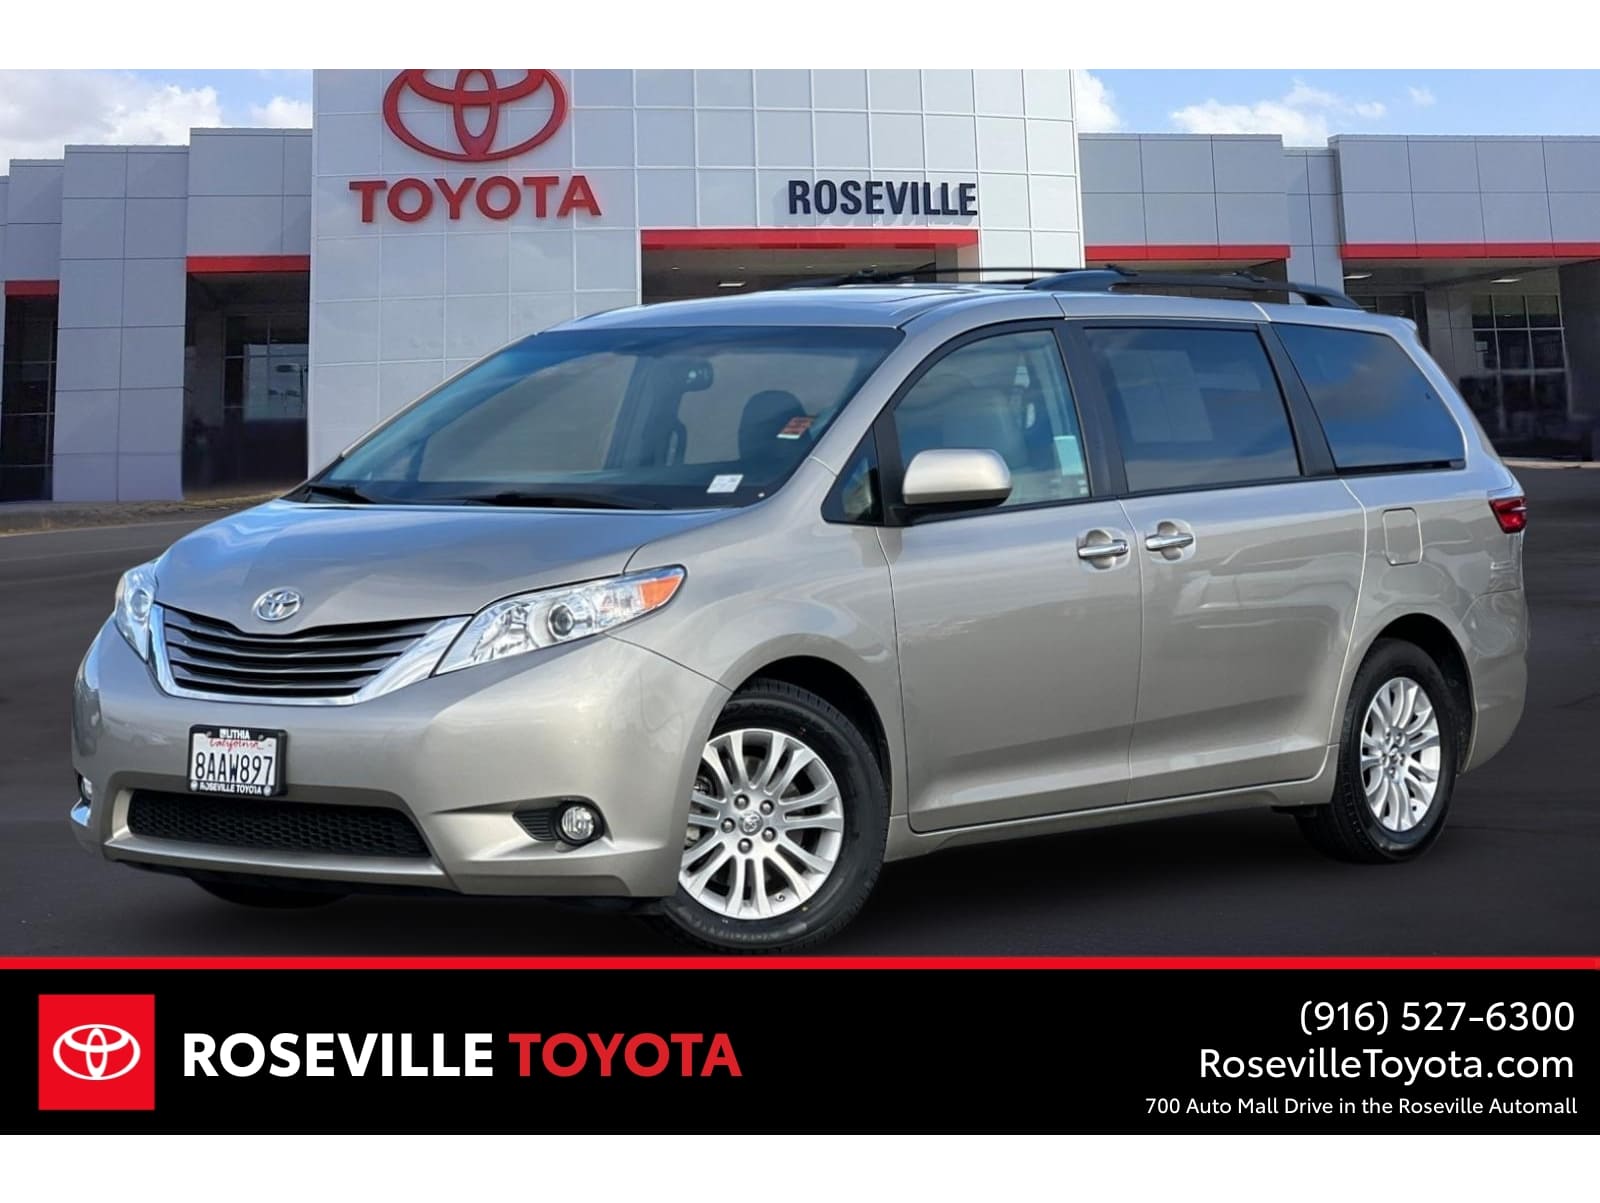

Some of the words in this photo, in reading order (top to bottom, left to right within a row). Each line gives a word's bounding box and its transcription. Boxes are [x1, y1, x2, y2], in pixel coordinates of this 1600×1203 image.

[349, 175, 602, 223] TOYOTA
[788, 180, 978, 216] ROSEVILLE
[227, 729, 250, 740] LITHIA
[195, 751, 273, 785] 8AAW897
[236, 784, 262, 794] TOYOTA
